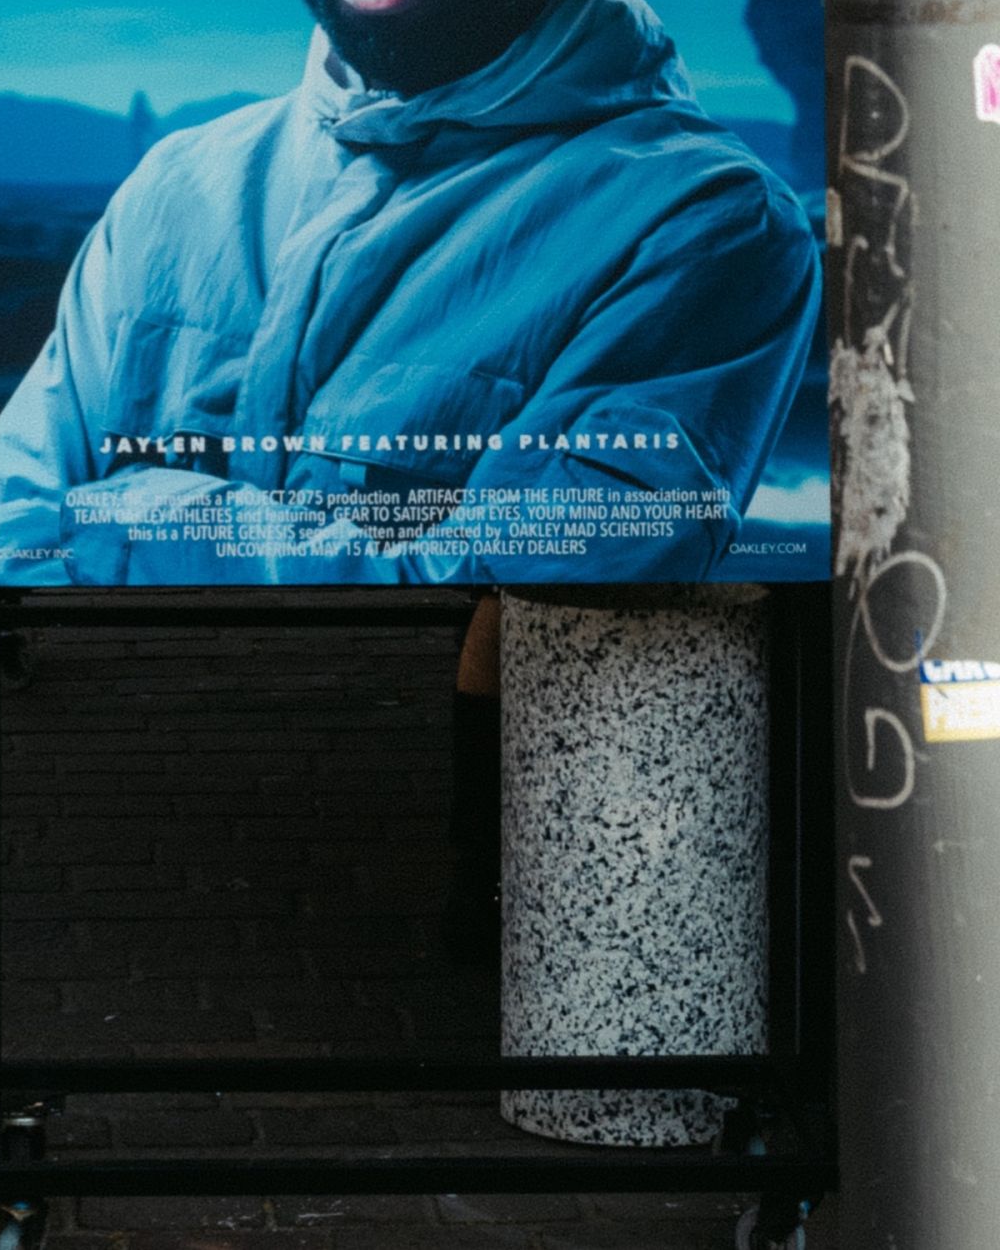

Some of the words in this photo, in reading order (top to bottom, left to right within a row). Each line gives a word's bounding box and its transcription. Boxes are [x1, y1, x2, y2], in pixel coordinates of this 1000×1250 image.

[100, 436, 206, 454] JAYLEN
[222, 435, 326, 453] BROWN
[341, 434, 503, 451] FEATURING
[519, 433, 680, 450] PLANTARIS
[215, 494, 222, 506] a
[226, 490, 285, 506] PROJECT
[288, 489, 324, 506] 2075
[327, 489, 400, 510] production
[407, 488, 476, 505] ARTIFACTS
[480, 488, 521, 505] FROM
[524, 487, 549, 504] THE
[553, 487, 604, 504] FUTURE
[608, 487, 620, 503] in
[624, 487, 699, 503] association
[701, 487, 731, 502] with
[74, 509, 111, 525] TEAM
[171, 507, 233, 524] ATHLETES
[235, 507, 261, 523] and
[264, 507, 326, 526] featuring
[333, 506, 369, 522] GEAR
[372, 505, 390, 522] TO
[393, 505, 447, 522] SATISFY
[448, 505, 486, 521] YOUR
[489, 504, 525, 523] EYES,
[527, 504, 566, 521] YOUR
[569, 504, 607, 520] MIND
[611, 503, 641, 520] AND
[643, 503, 682, 520] YOUR
[686, 503, 729, 519] HEART
[128, 525, 153, 541] this
[156, 526, 167, 541] is
[171, 529, 178, 541] a
[183, 525, 234, 541] FUTURE
[238, 524, 296, 540] GENESIS
[349, 524, 394, 539] written
[398, 523, 423, 539] and
[427, 523, 481, 538] directed
[485, 523, 501, 541] by
[509, 522, 561, 538] OAKLEY
[564, 522, 596, 538] MAD
[601, 521, 674, 537] SCIENTISTS
[216, 541, 307, 557] UNCOVERING
[346, 540, 362, 557] 15
[383, 540, 470, 556] AUTHORIZED
[473, 540, 525, 556] OAKLEY
[528, 539, 587, 555] DEALERS
[728, 543, 807, 555] OAKLEY.COM
